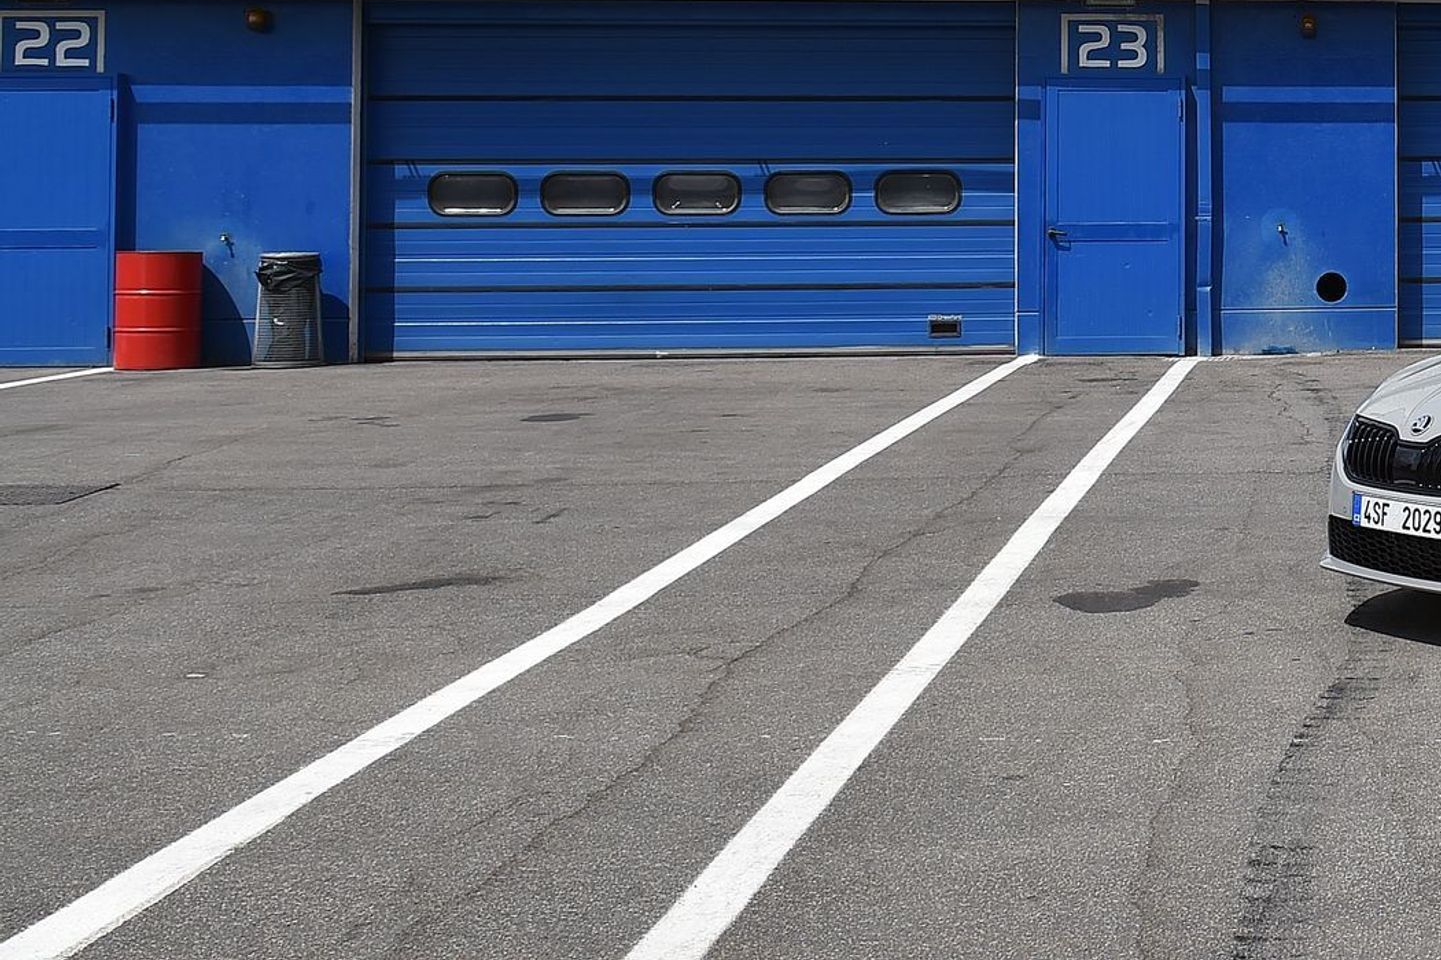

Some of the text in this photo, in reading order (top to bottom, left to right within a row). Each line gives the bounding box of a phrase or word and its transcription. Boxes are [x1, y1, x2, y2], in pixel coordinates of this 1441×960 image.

[14, 21, 91, 67] 22
[1078, 24, 1148, 68] 23
[1363, 500, 1390, 527] 4SF
